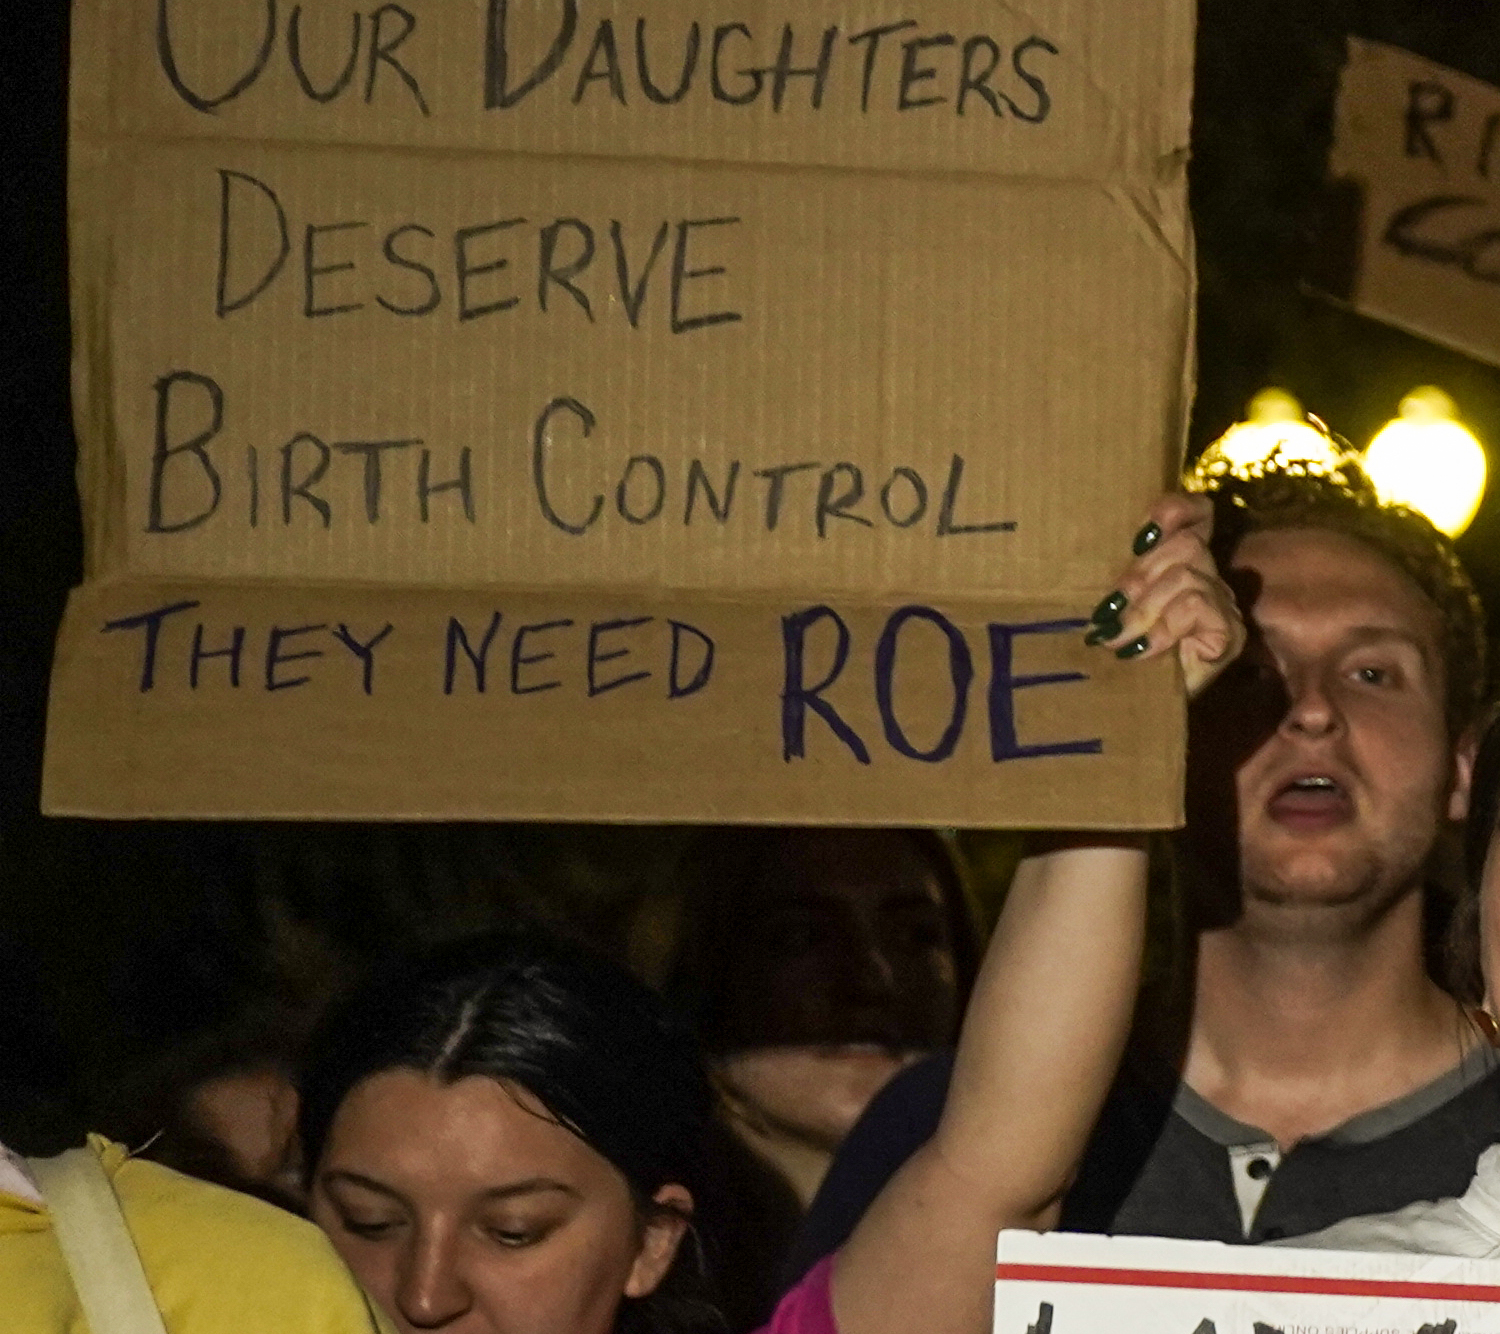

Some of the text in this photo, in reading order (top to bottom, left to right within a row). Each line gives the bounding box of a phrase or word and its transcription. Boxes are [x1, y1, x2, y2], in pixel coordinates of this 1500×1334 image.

[101, 599, 1104, 765] THEY NEED ROE
